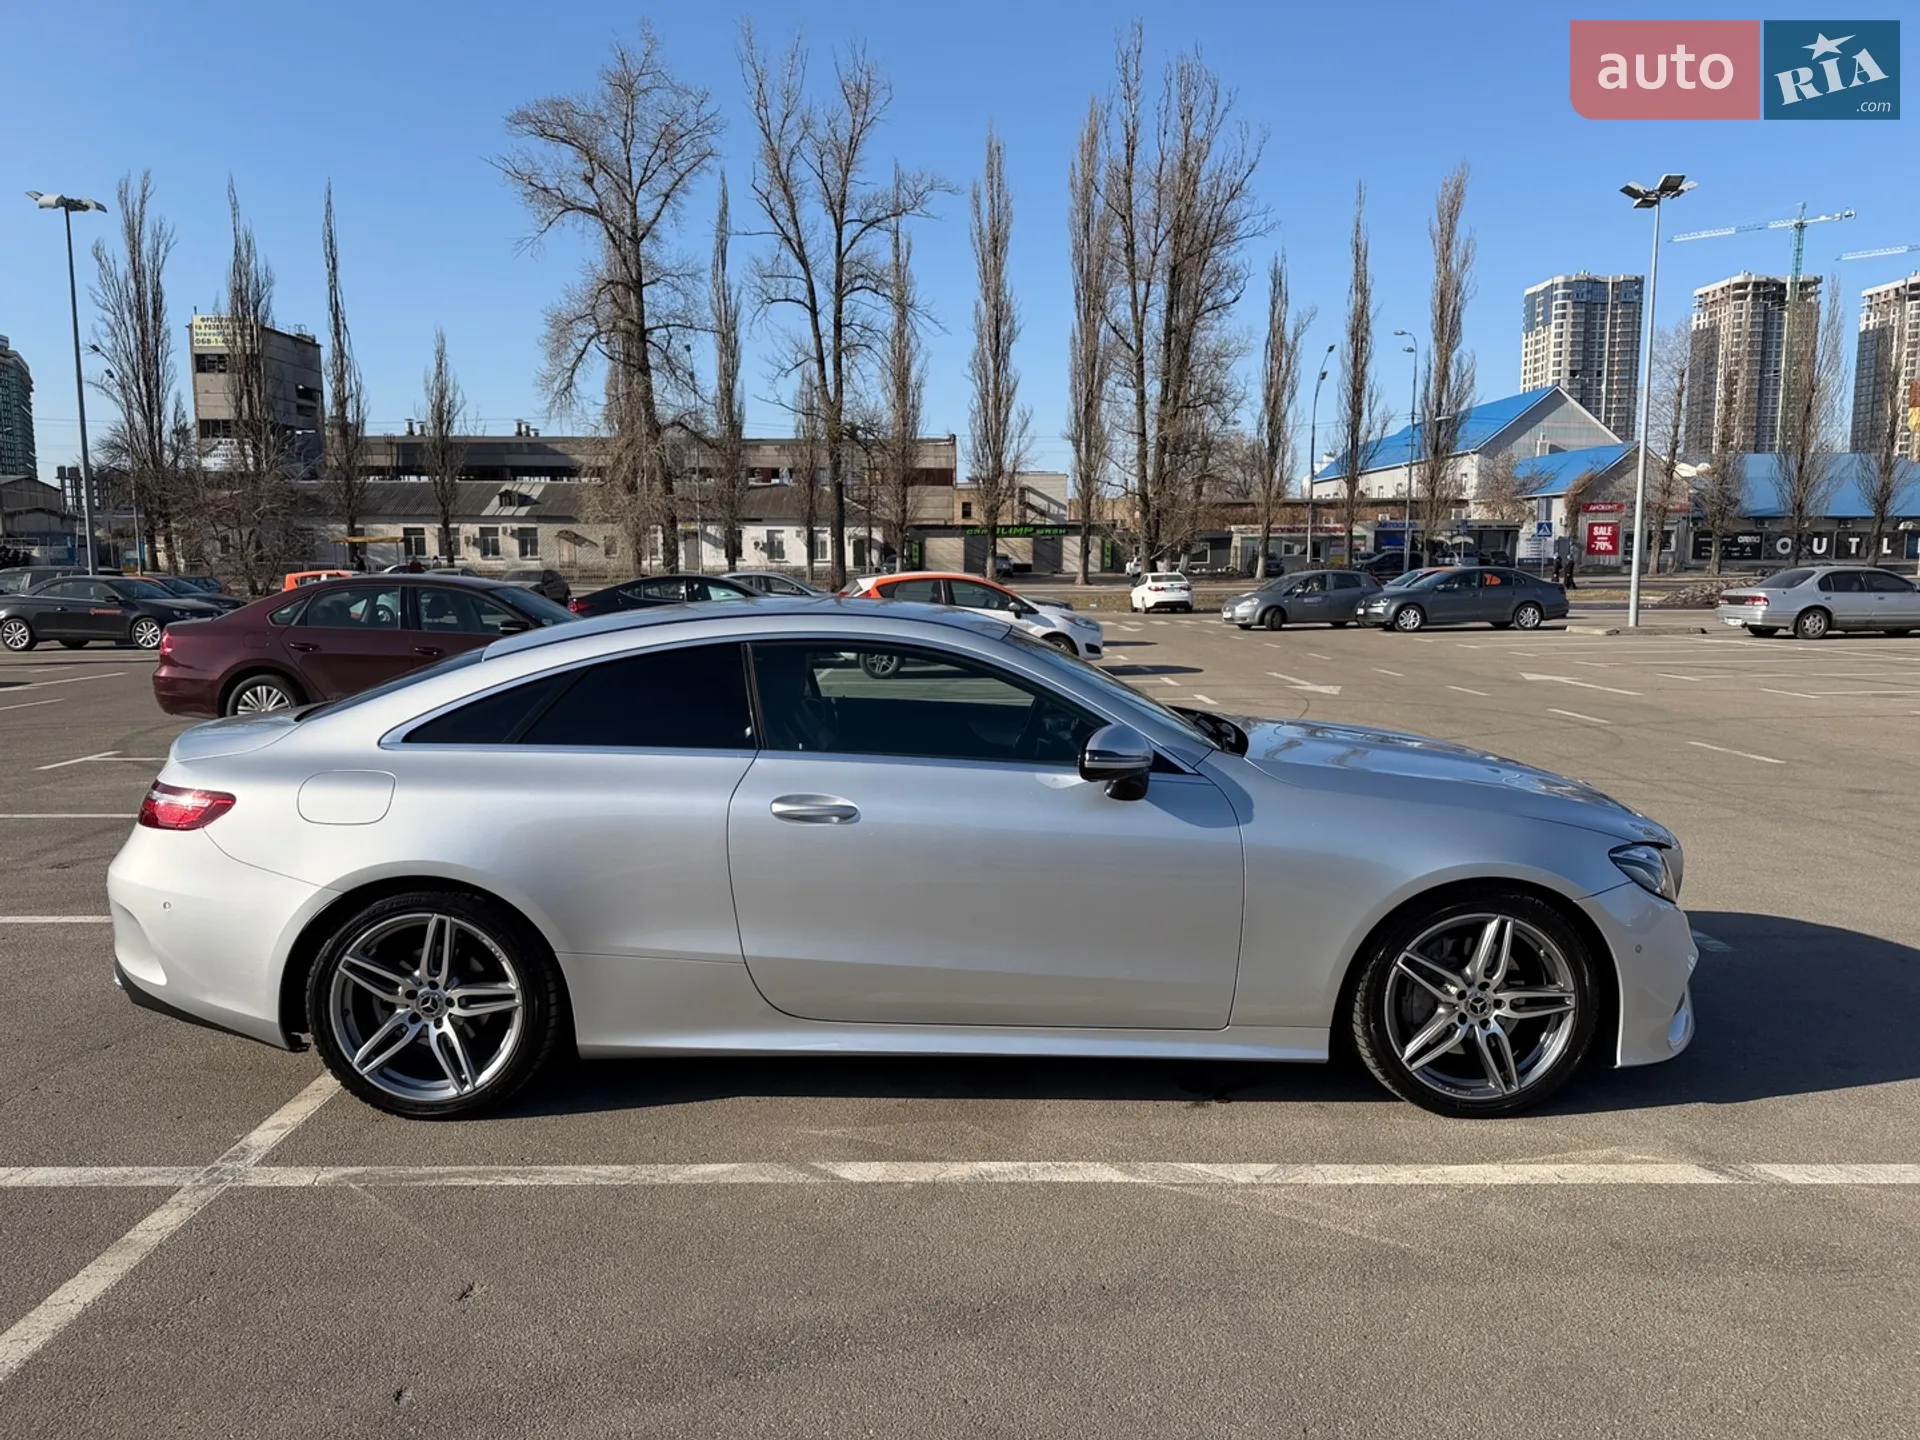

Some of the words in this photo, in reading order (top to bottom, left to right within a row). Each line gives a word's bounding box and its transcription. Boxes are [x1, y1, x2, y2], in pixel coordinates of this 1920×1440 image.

[1592, 526, 1613, 536] SALE
[1591, 541, 1613, 551] -70%
[1776, 537, 1920, 555] OUTL
